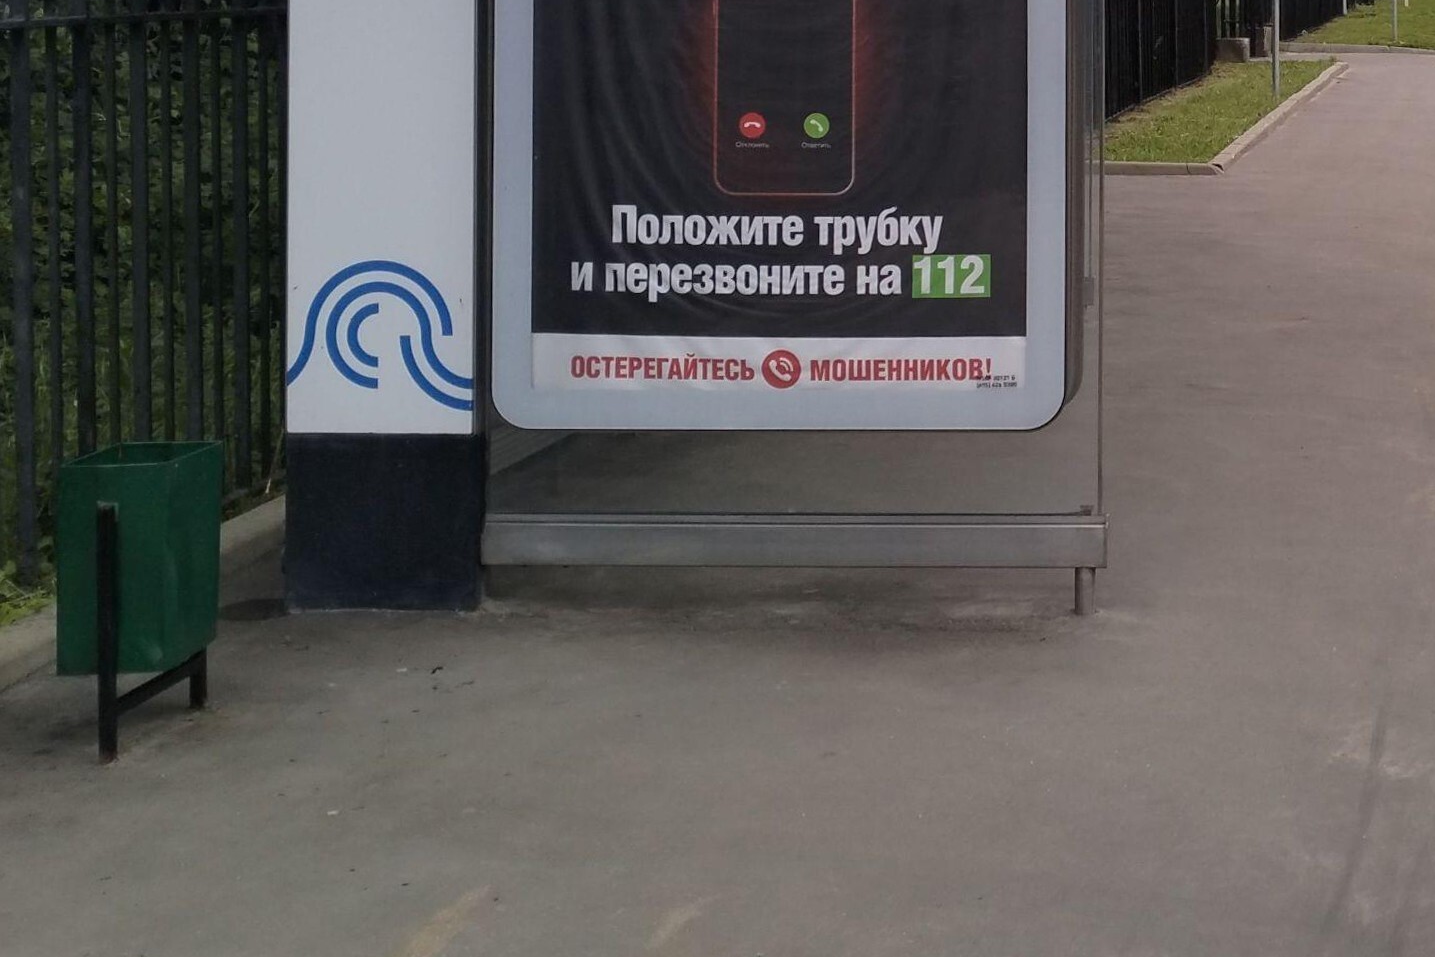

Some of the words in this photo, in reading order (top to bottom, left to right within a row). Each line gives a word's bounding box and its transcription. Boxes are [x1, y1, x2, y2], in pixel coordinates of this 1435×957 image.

[612, 204, 803, 246] Положите
[815, 207, 943, 254] трубку
[571, 262, 593, 291] и
[605, 262, 844, 302] перезвоните
[857, 262, 901, 295] на
[914, 255, 985, 296] 112
[570, 352, 755, 382] ОСТЕРЕГАЙТЕСЬ
[810, 357, 992, 383] МОШЕННИКОВ!
